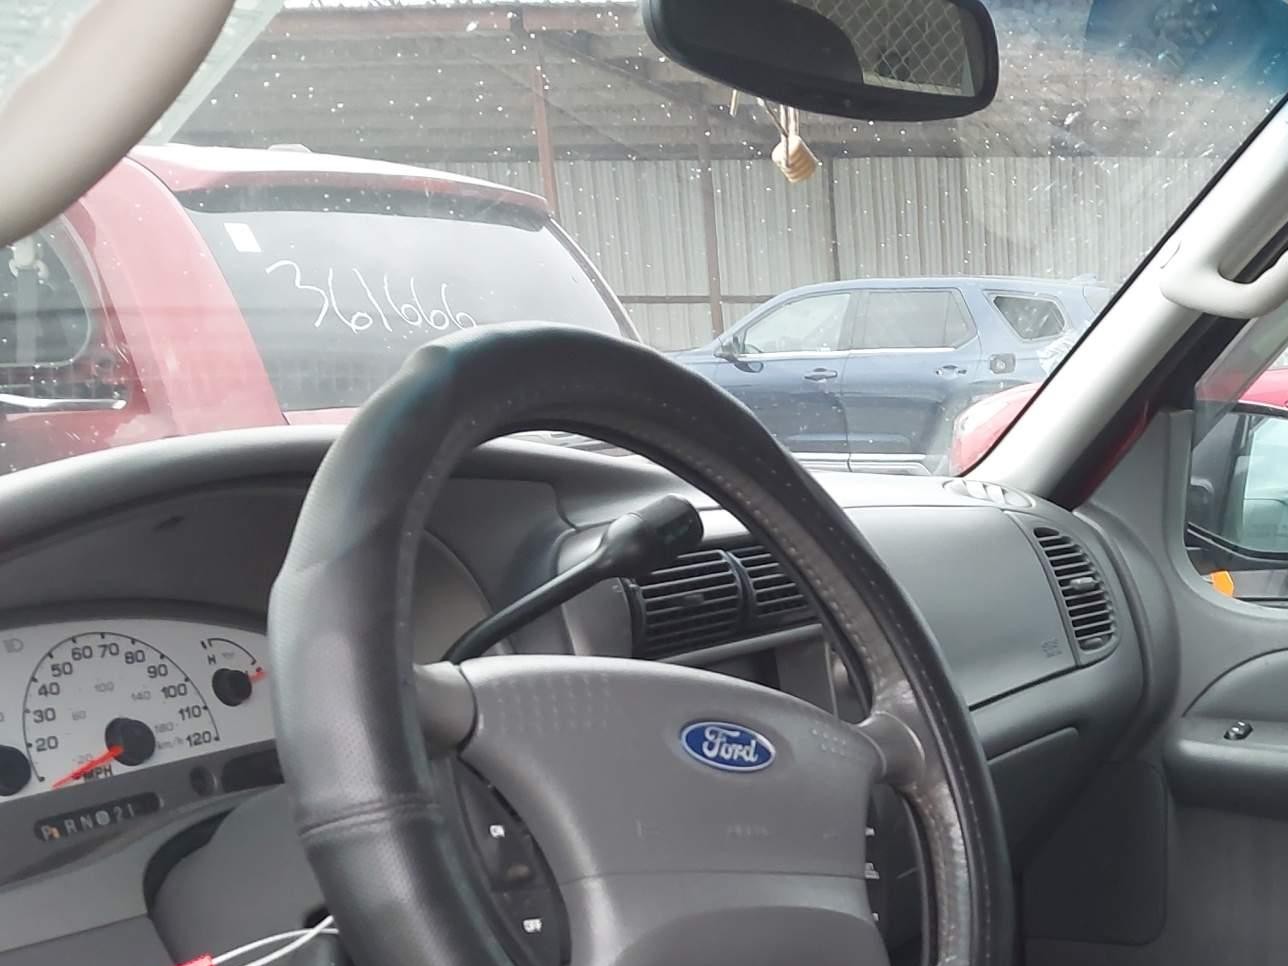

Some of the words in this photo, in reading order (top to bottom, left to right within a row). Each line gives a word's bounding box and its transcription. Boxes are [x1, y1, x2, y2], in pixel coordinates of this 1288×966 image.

[71, 645, 93, 661] 60
[98, 642, 120, 658] 70
[124, 649, 146, 665] 80
[207, 654, 217, 665] H
[50, 661, 73, 678] 50
[147, 663, 168, 679] 90
[37, 681, 60, 697] 40
[161, 683, 187, 699] 100
[32, 707, 56, 724] 30
[178, 704, 202, 721] 110
[34, 735, 58, 752] 20
[186, 730, 212, 748] 120
[702, 726, 758, 762] Ford
[63, 818, 78, 835] R
[79, 813, 94, 830] N
